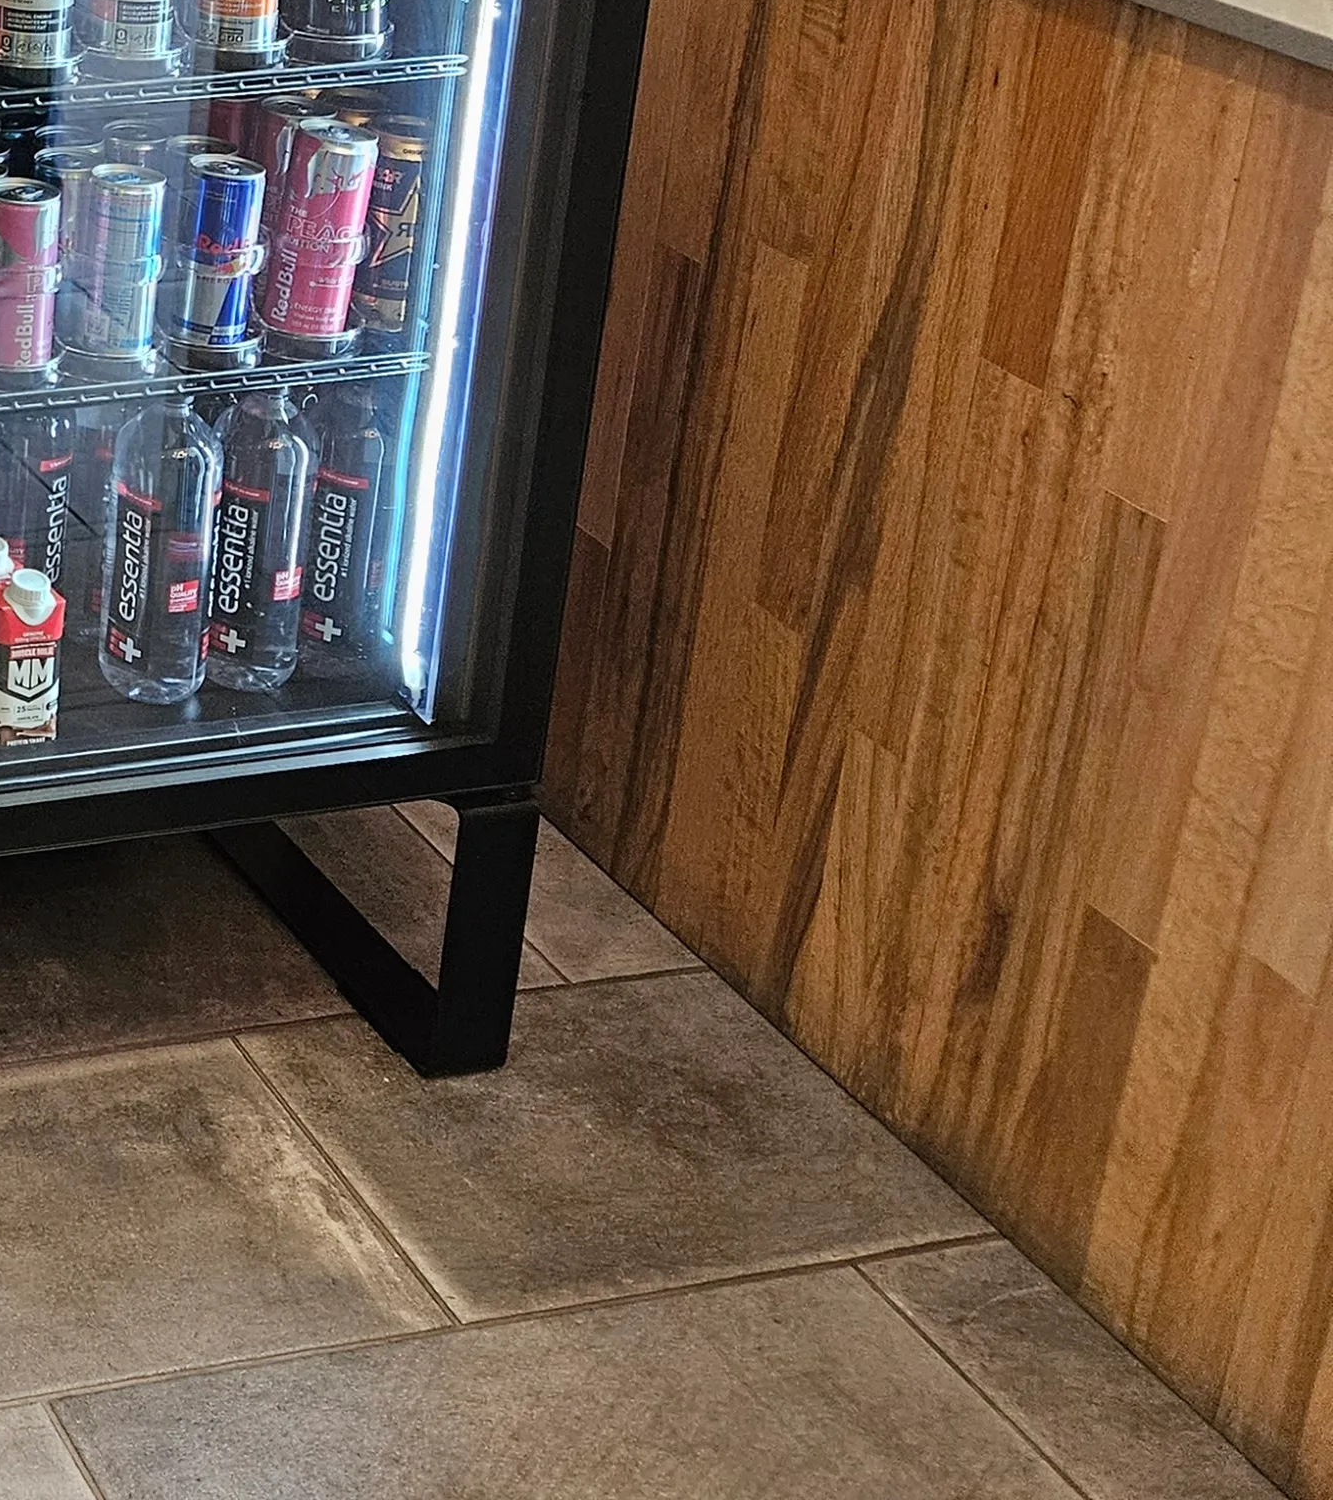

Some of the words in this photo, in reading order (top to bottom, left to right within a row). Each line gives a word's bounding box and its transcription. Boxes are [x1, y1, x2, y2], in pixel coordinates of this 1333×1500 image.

[290, 205, 308, 217] THE
[287, 215, 358, 241] PEAC
[271, 248, 298, 323] RedBull
[294, 302, 323, 314] ENERGY
[251, 510, 259, 531] water
[348, 498, 357, 518] water
[44, 475, 68, 584] essentia
[145, 519, 153, 536] water
[345, 518, 354, 544] alkaline
[218, 503, 251, 614] essentia
[314, 493, 348, 602] essentia
[119, 510, 145, 622] essentia
[171, 584, 183, 592] pH
[8, 657, 55, 698] MM
